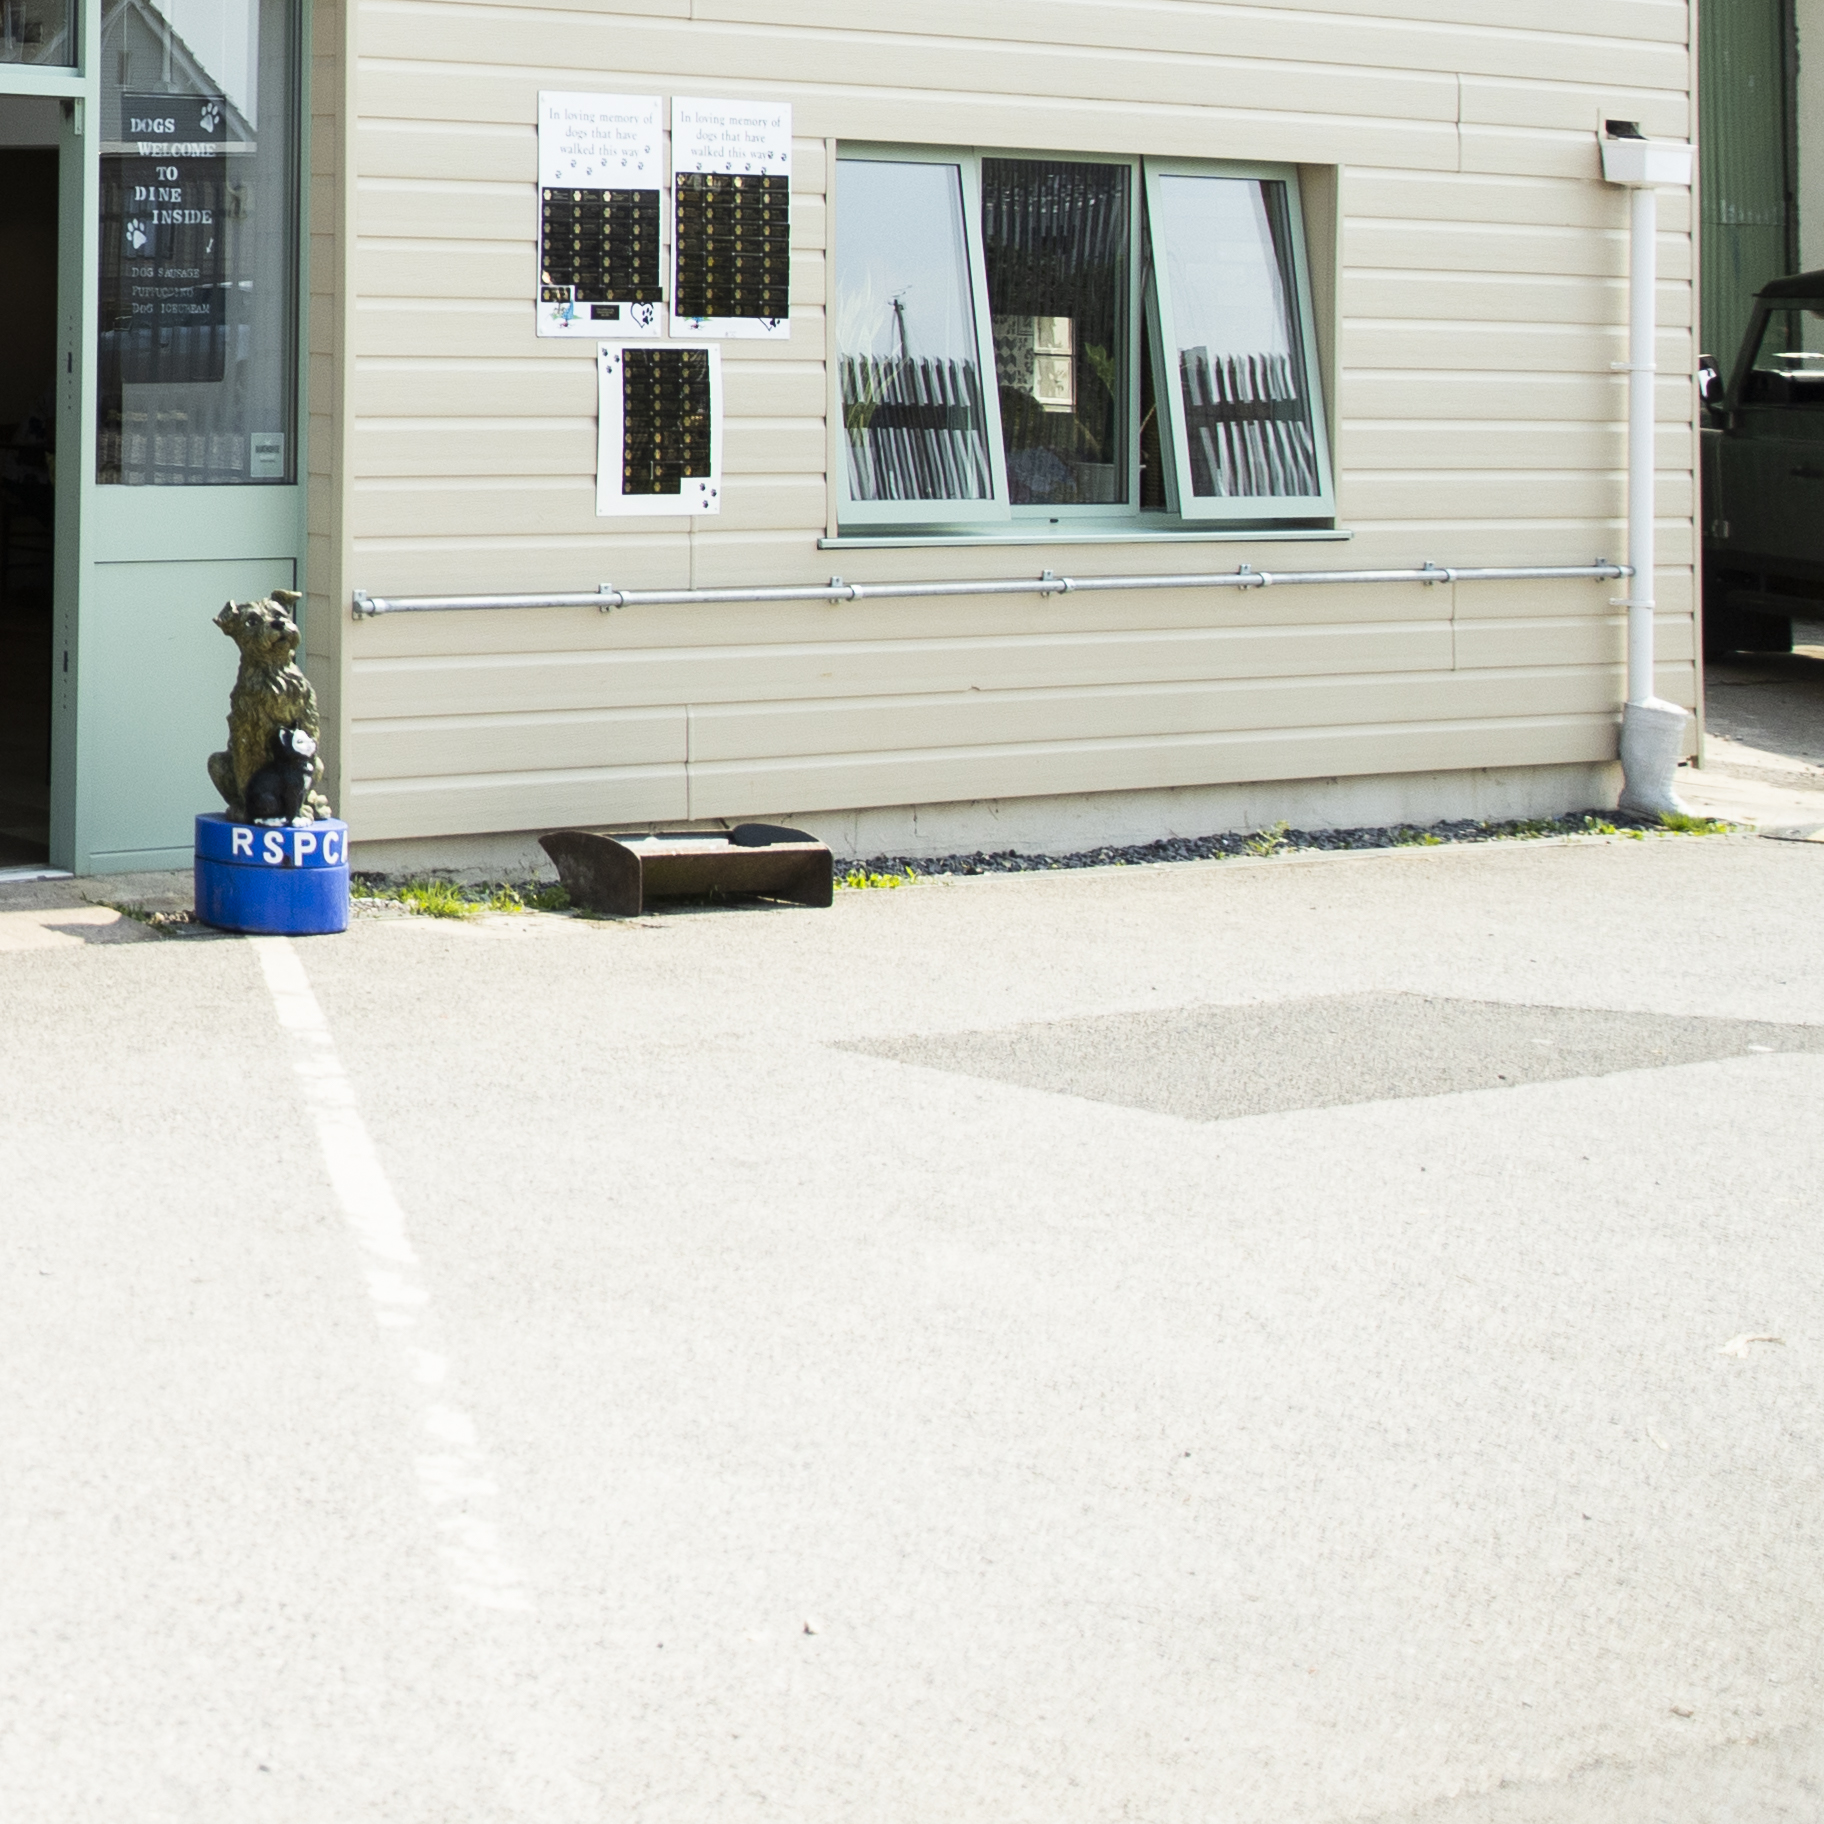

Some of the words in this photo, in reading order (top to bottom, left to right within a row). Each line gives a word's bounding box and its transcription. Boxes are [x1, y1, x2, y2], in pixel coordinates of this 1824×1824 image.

[549, 107, 560, 120] In
[564, 108, 595, 123] loving
[599, 113, 639, 124] memory
[643, 112, 653, 124] of
[680, 110, 691, 123] In
[695, 111, 725, 126] loving
[729, 116, 768, 128] memory
[771, 116, 781, 127] of
[130, 118, 175, 133] DOGS
[565, 125, 587, 139] dogs
[591, 127, 611, 139] that
[616, 127, 637, 140] have
[696, 128, 717, 142] dogs
[721, 129, 740, 141] that
[745, 130, 766, 143] have
[137, 141, 216, 157] WELCOME
[560, 143, 595, 155] walked
[599, 144, 617, 156] this
[621, 148, 639, 159] way
[691, 145, 724, 158] walked
[728, 146, 746, 158] this
[750, 151, 767, 161] way
[156, 166, 178, 181] TO
[134, 186, 182, 203] DINE
[152, 209, 212, 224] INSIDE
[132, 267, 154, 278] DOG
[157, 267, 200, 278] SAUSAGE
[132, 302, 154, 314] DOG
